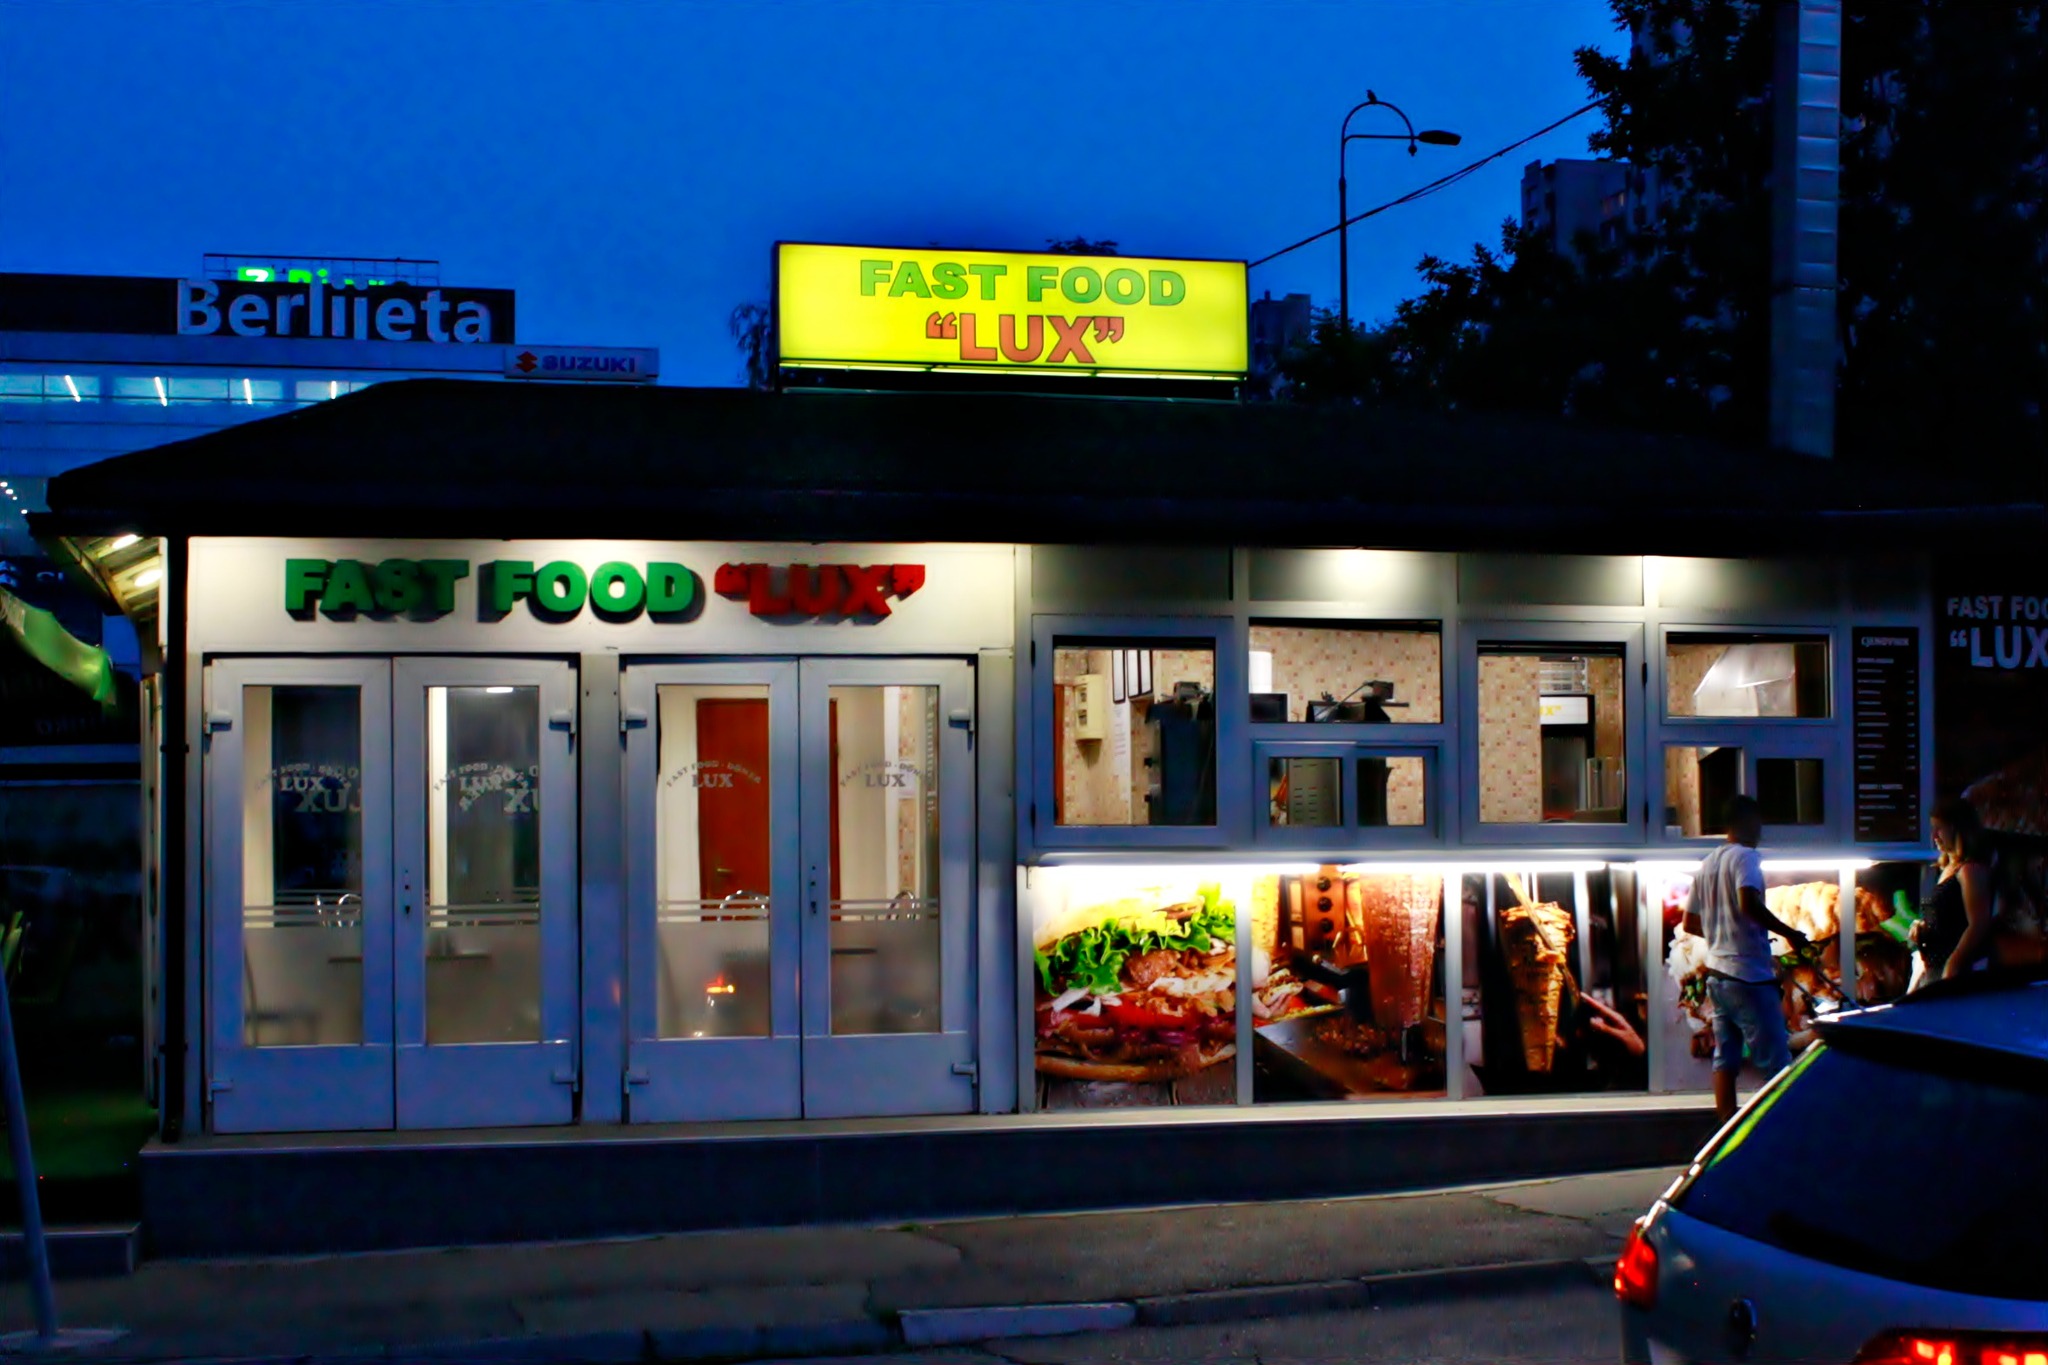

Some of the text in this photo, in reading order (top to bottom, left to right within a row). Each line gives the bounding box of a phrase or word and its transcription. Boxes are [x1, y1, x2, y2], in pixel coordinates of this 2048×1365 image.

[859, 258, 1187, 307] FAST FOOD
[177, 278, 492, 344] Berlijeta
[925, 311, 1125, 364] “LUX”
[541, 355, 635, 373] SUZUKI
[285, 558, 470, 615] FAST
[490, 560, 697, 616] FOOD
[1946, 595, 2004, 620] FAST
[280, 776, 325, 791] LUX
[666, 766, 688, 787] FAST
[692, 760, 719, 771] FOOD
[692, 773, 733, 788] LUX
[865, 774, 906, 787] LUX
